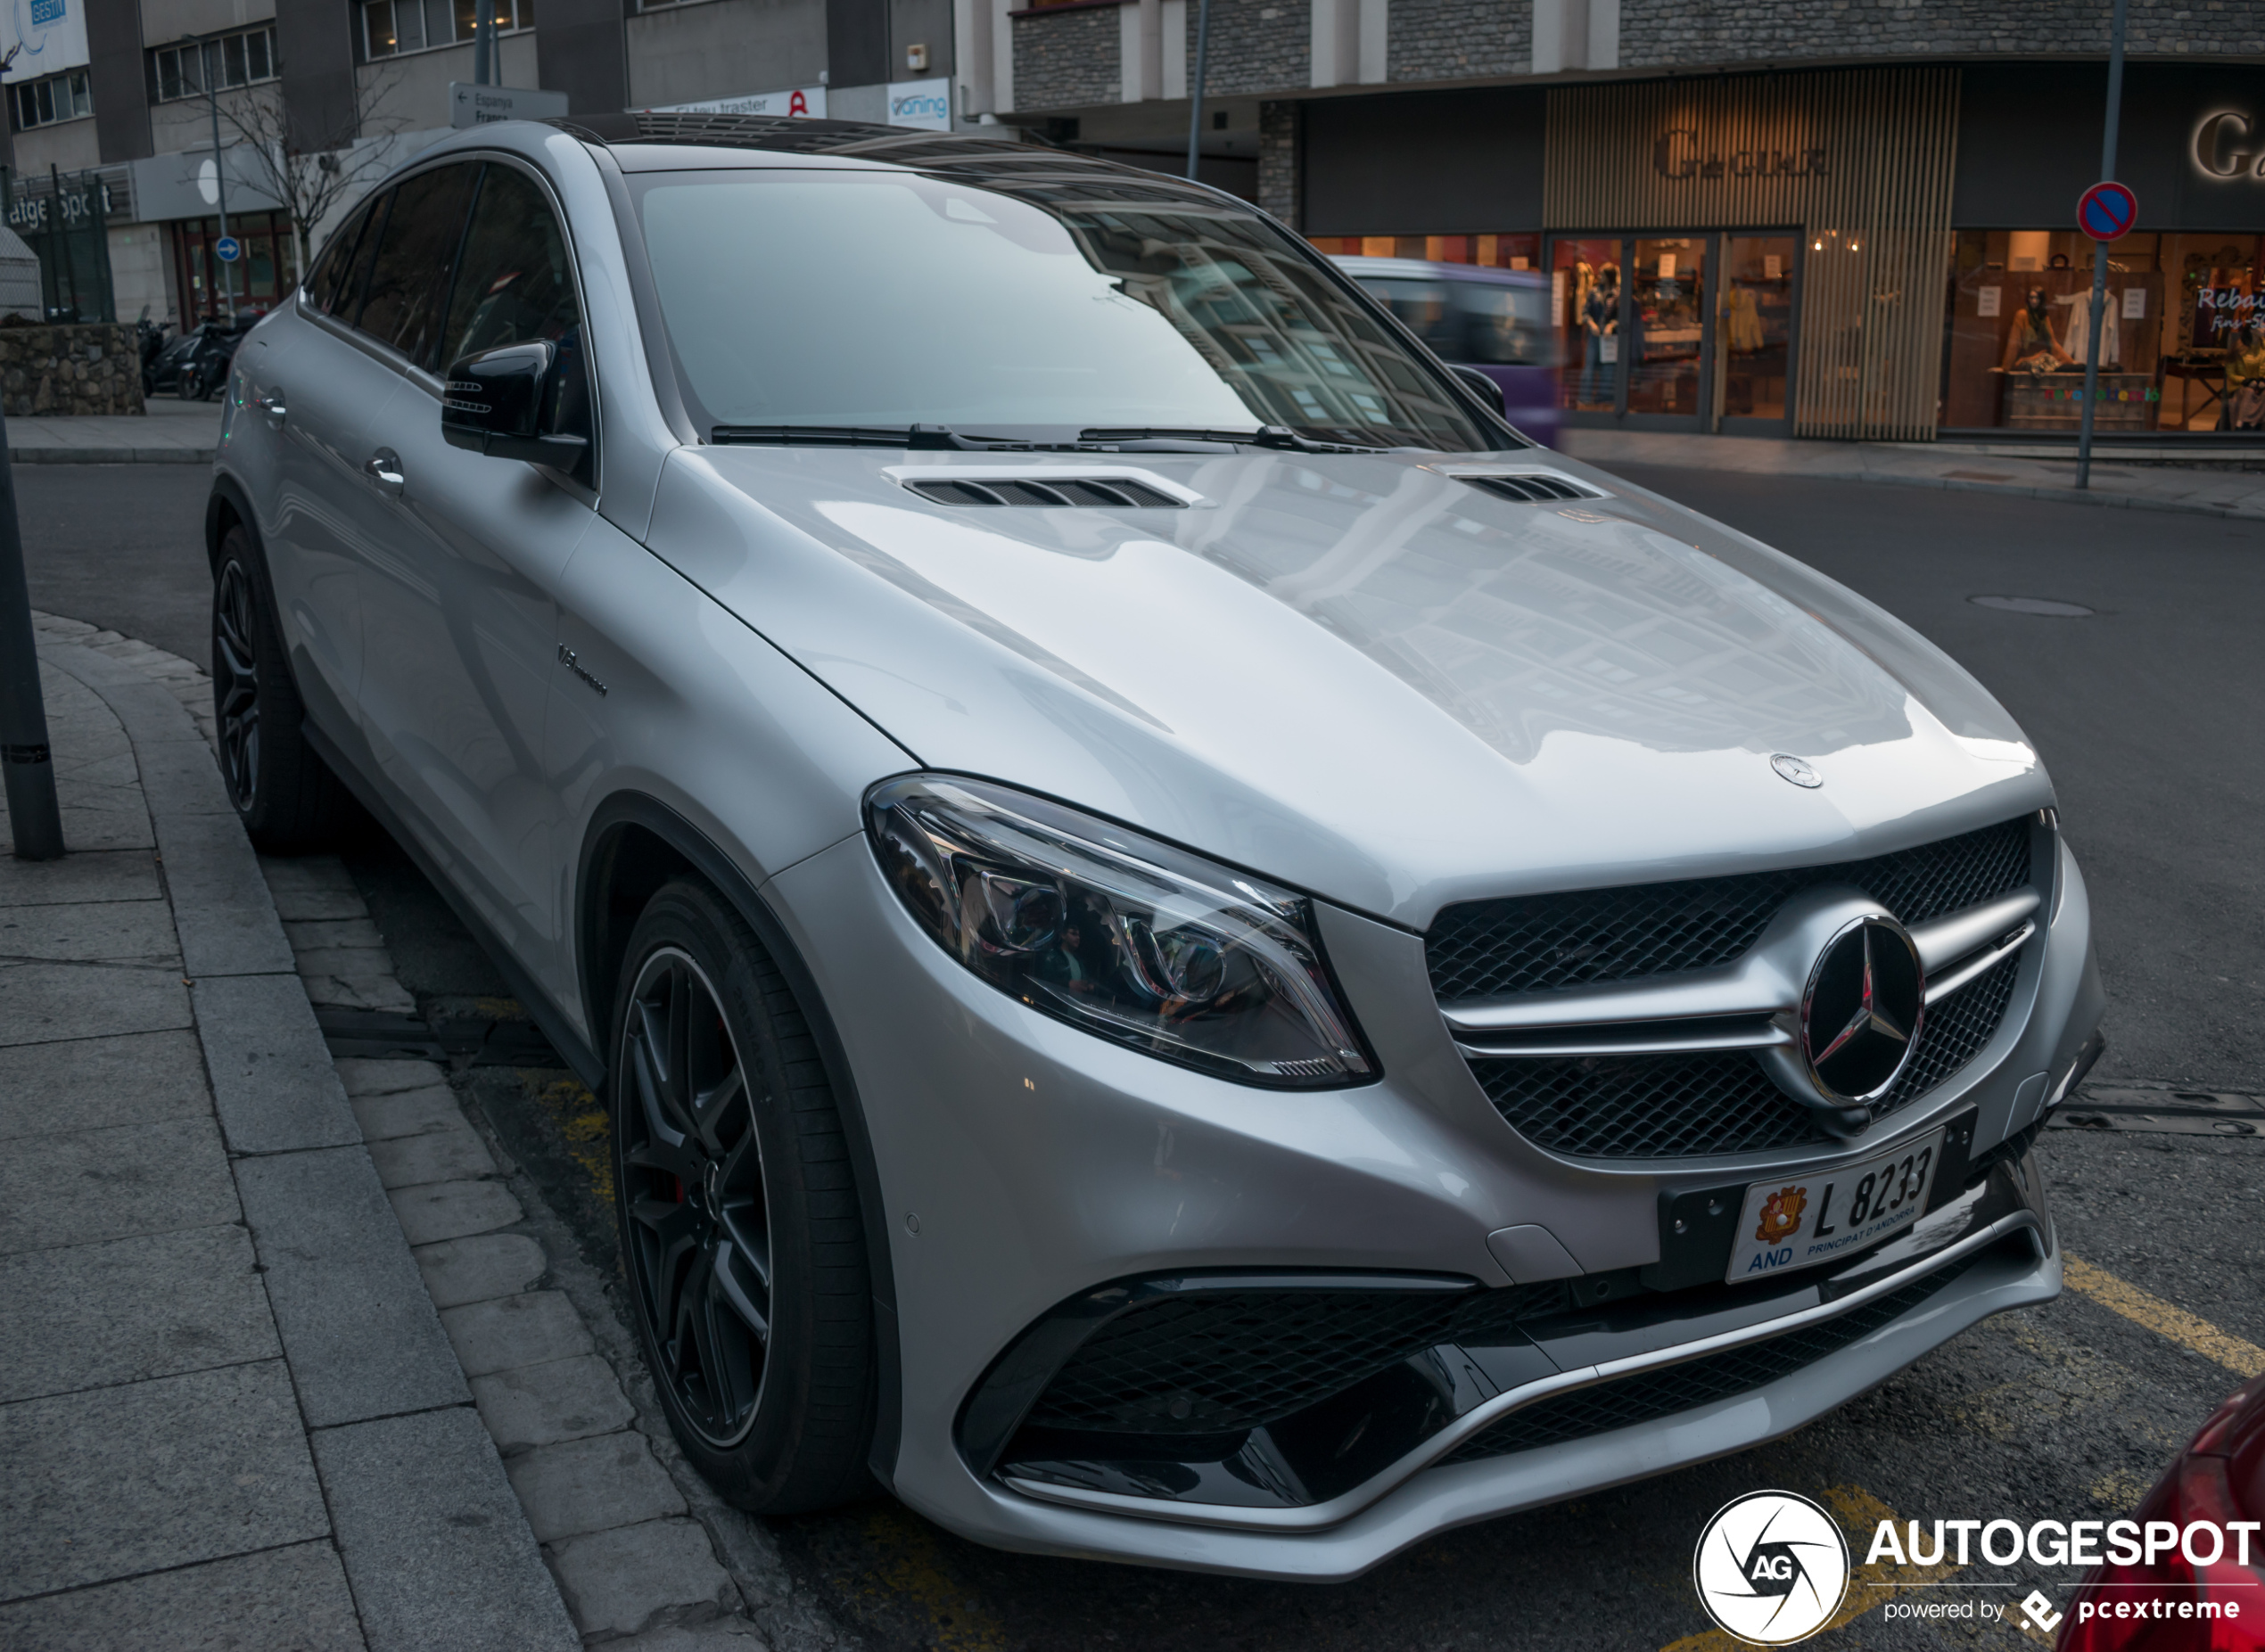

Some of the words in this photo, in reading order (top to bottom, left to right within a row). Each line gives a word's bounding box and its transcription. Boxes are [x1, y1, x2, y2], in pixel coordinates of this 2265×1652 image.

[475, 93, 513, 111] Espanya
[721, 99, 768, 114] traster
[2044, 389, 2083, 400] nova
[1814, 1182, 1835, 1238] L
[1849, 1146, 1932, 1228] 8233
[1807, 1230, 1865, 1255] PRINCIPAT
[1866, 1205, 1915, 1237] D'ANDORRA
[1748, 1247, 1793, 1272] AND
